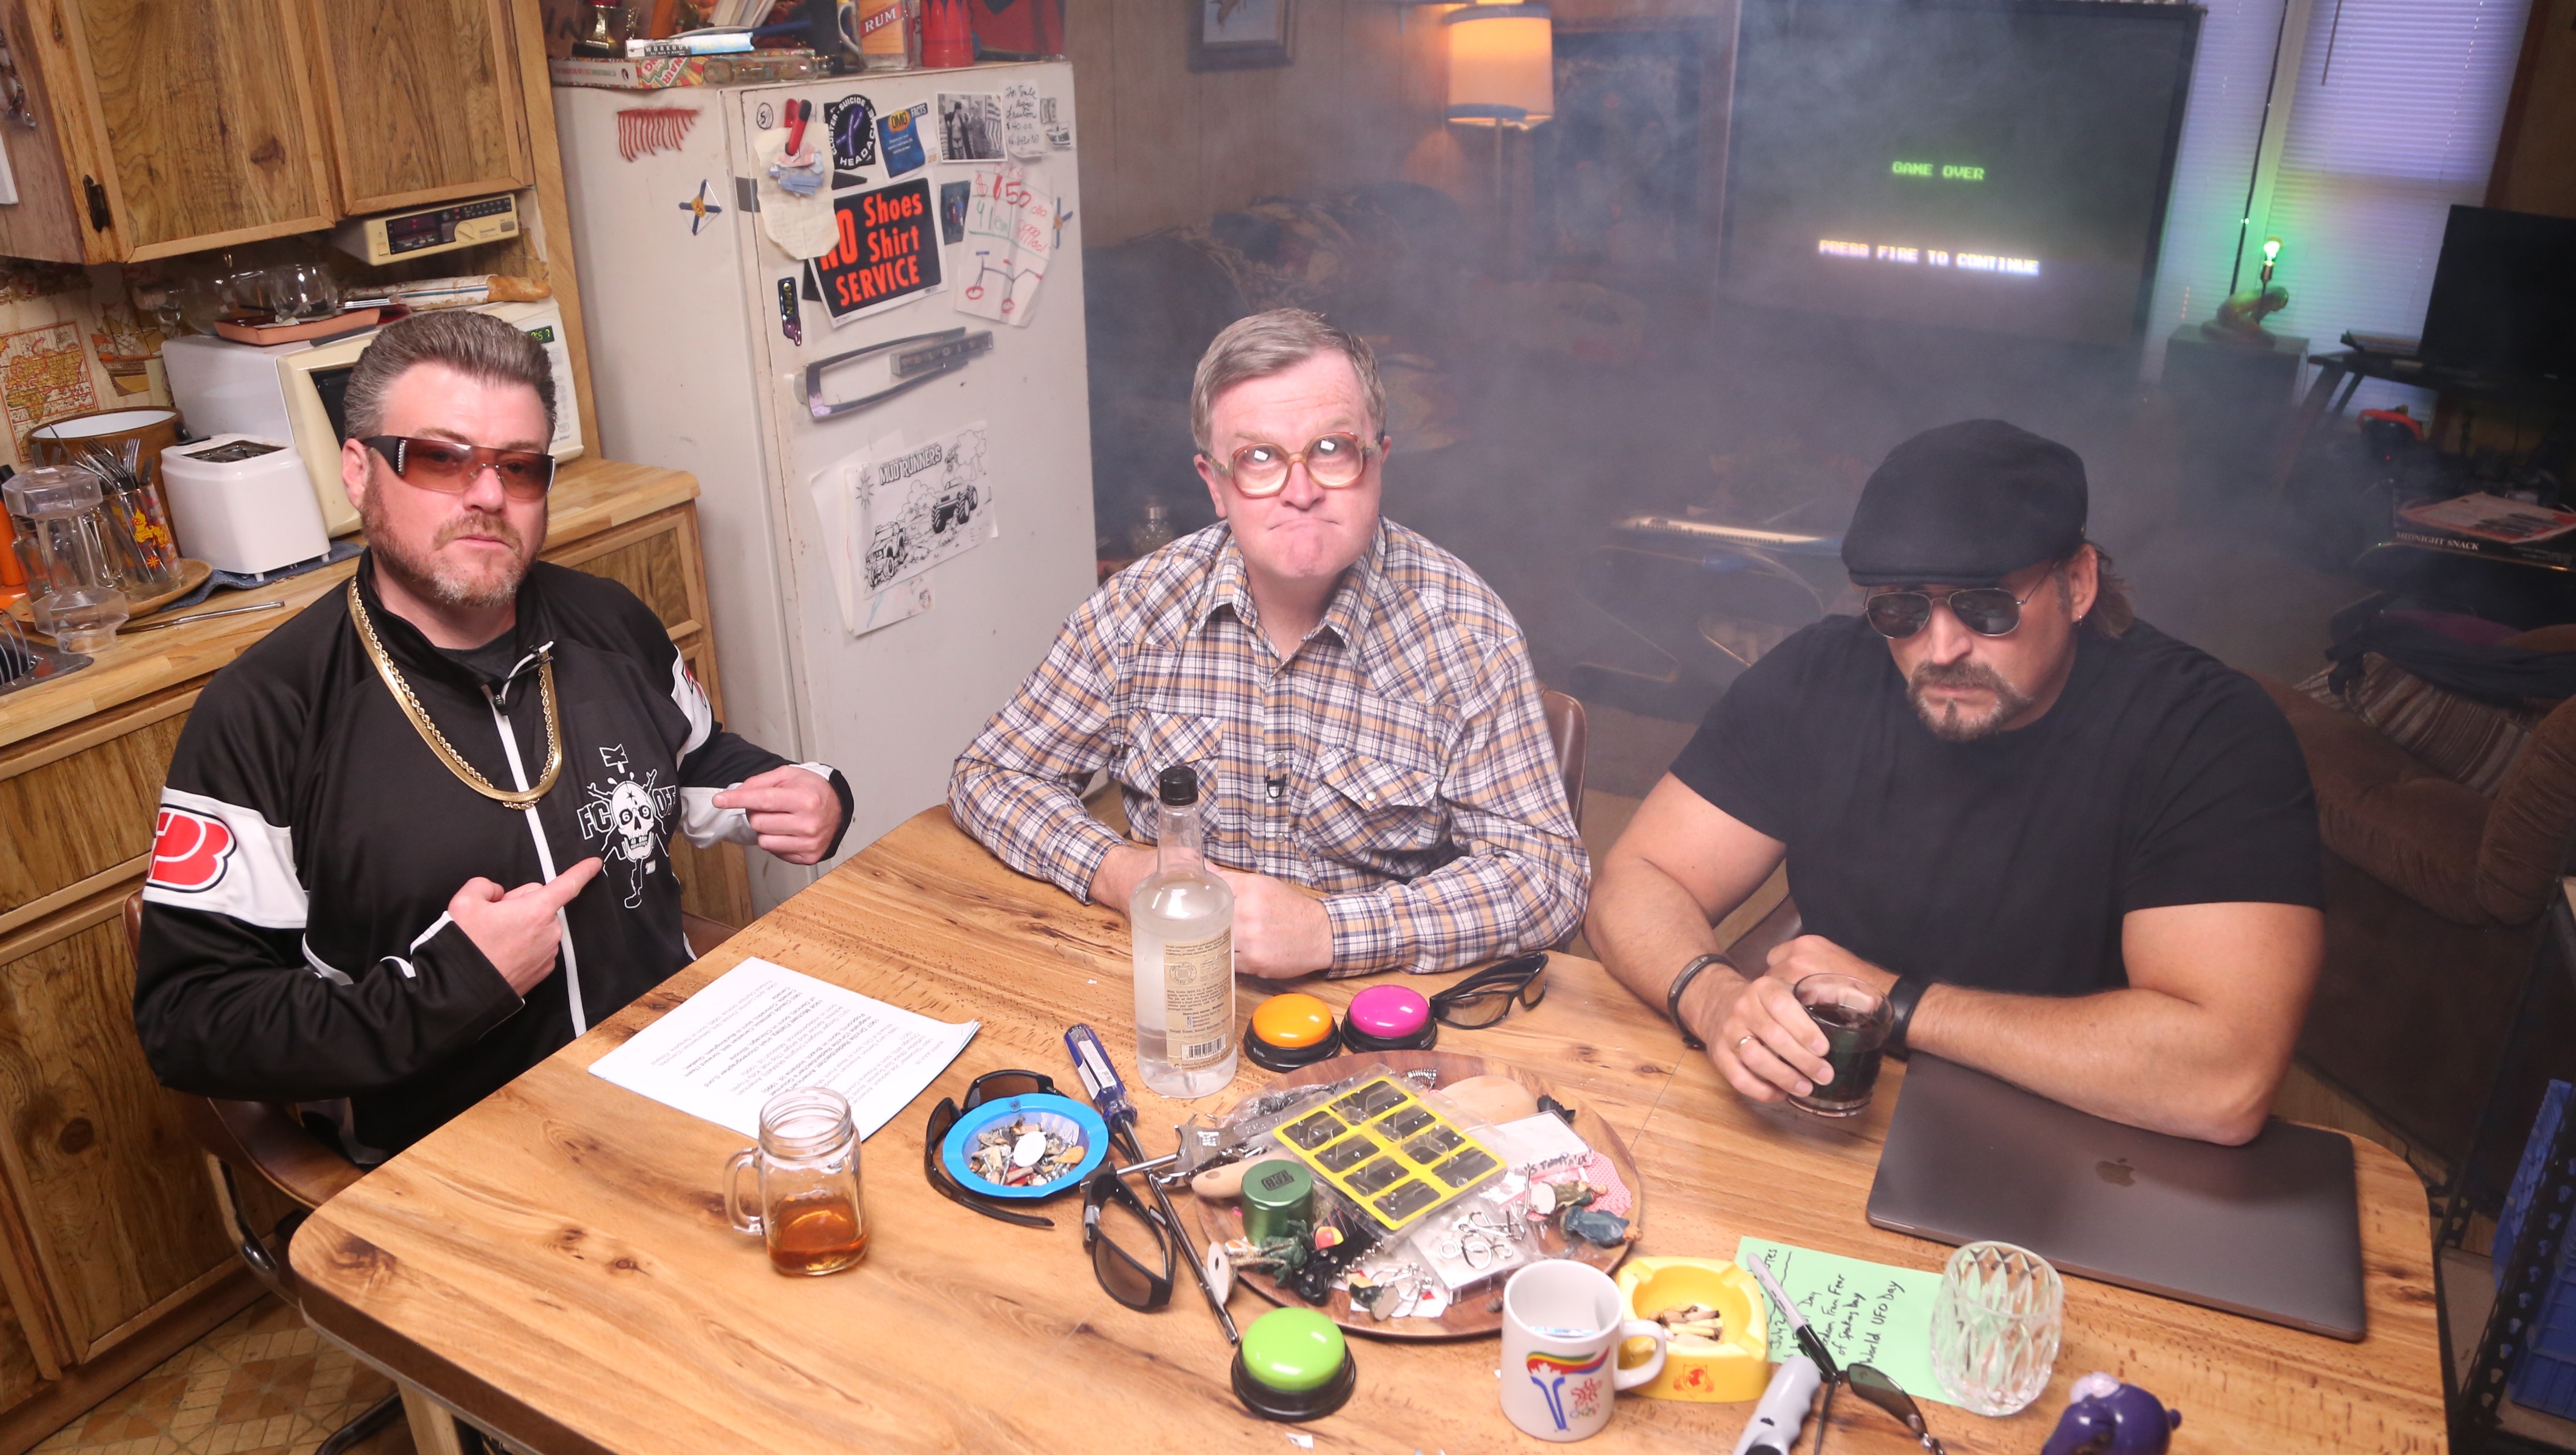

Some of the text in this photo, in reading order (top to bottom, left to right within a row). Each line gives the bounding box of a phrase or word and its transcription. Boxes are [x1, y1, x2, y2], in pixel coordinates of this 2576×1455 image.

[864, 7, 897, 33] RUM
[645, 44, 690, 52] WORKOUT
[829, 96, 866, 156] CLUSTER SUICIDE
[891, 104, 927, 129] OMG FACTS
[839, 108, 876, 166] HEADACHE
[1892, 160, 1985, 181] GAME OVER
[863, 193, 923, 227] Shoes
[867, 226, 919, 262] Shirt
[1818, 239, 2040, 276] PRESS FIRE TO CONTINUE
[836, 255, 920, 306] SERVICE
[878, 443, 942, 486] MUD RUNNERS
[2396, 530, 2480, 551] MIDNIGHT SNACK
[653, 784, 676, 819] OFF
[622, 805, 650, 823] 6 9
[810, 1000, 822, 1008] 1958
[777, 1016, 790, 1024] born
[791, 1009, 810, 1023] Michael
[867, 1019, 879, 1028] 1907
[759, 1037, 772, 1046] Irish
[827, 1032, 840, 1041] born
[849, 1028, 867, 1040] Orville
[721, 1047, 758, 1074] choreographer
[730, 1047, 749, 1059] Illinois
[770, 1016, 871, 1095] magnate (Orville Redenbacher's Gourmet
[785, 1060, 806, 1075] Indiana
[704, 1075, 720, 1087] (Lord
[761, 1083, 777, 1092] 1995)
[791, 1069, 816, 1088] American
[1827, 1274, 1845, 1296] Fear
[1858, 1280, 1906, 1364] World UFO Day
[1831, 1341, 1847, 1356] of
